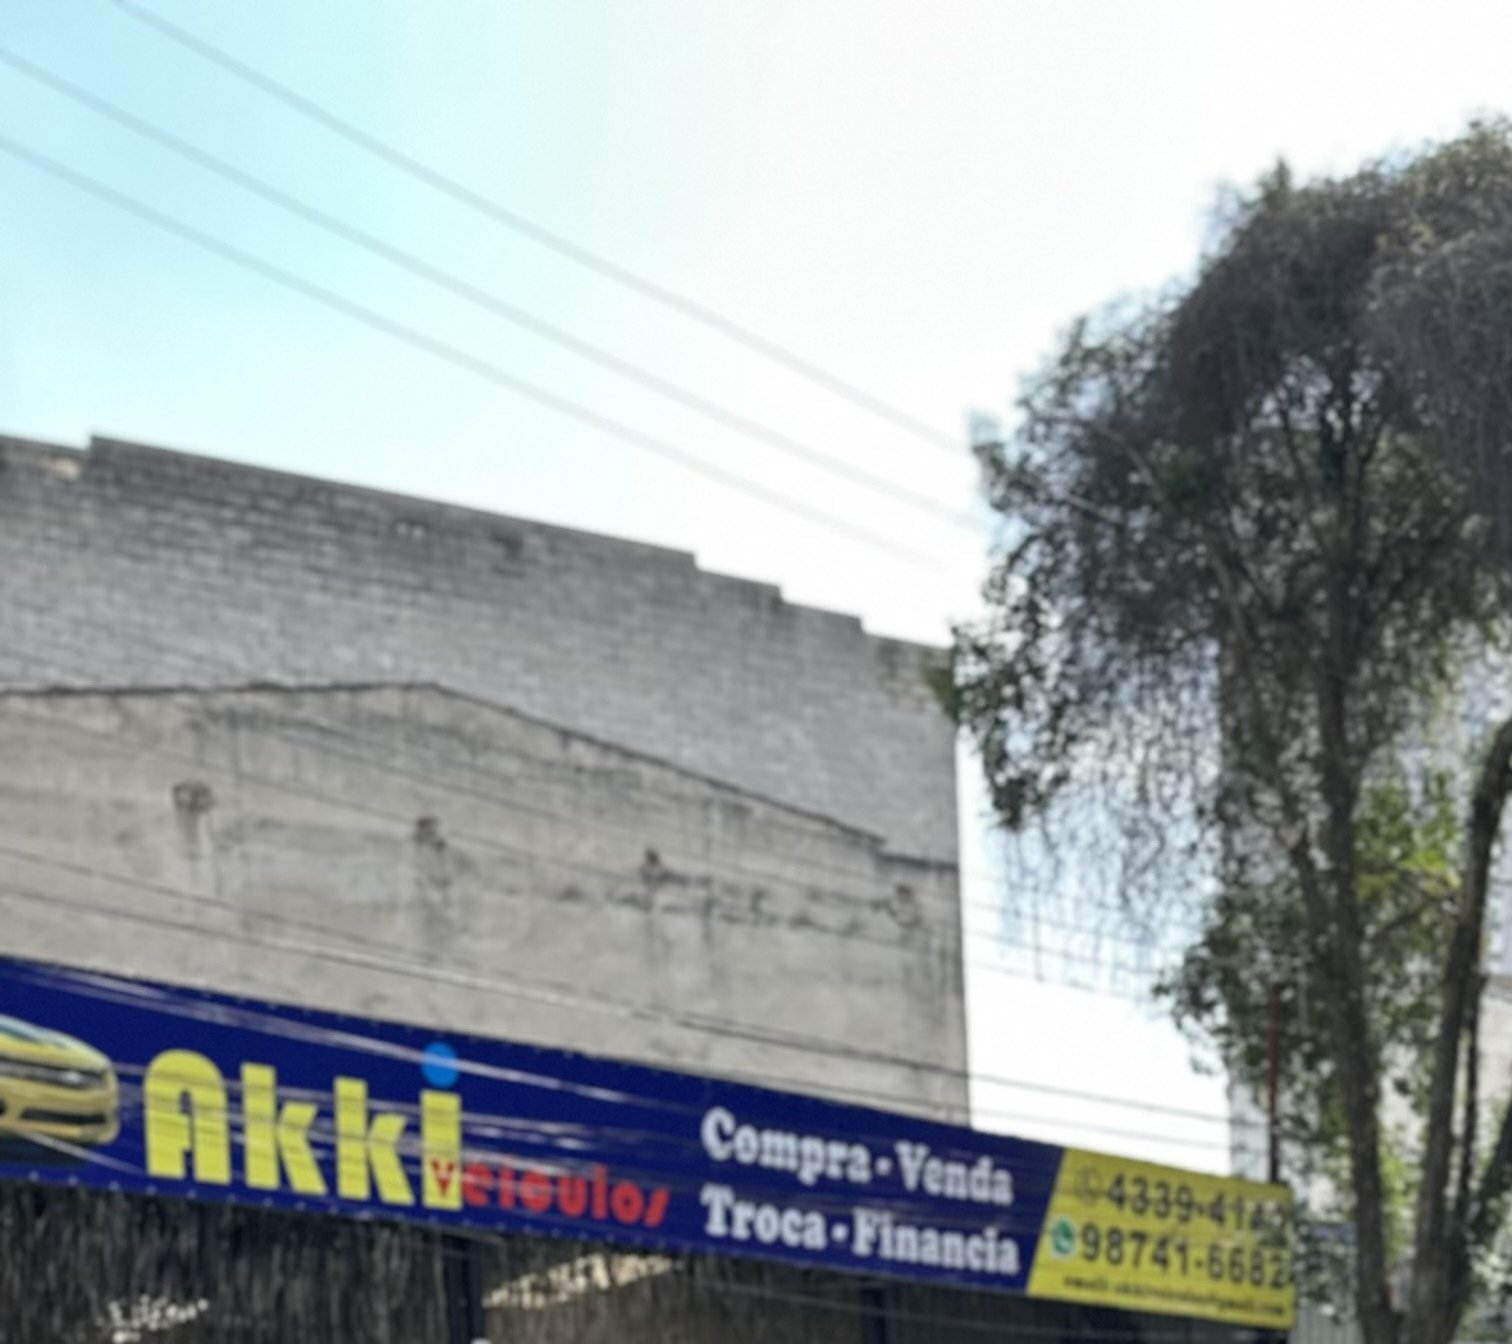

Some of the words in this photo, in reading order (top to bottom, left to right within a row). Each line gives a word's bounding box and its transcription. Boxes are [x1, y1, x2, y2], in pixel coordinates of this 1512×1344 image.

[143, 1042, 464, 1212] Akki
[701, 1106, 872, 1186] Compra
[896, 1139, 1014, 1206] Venda
[700, 1181, 828, 1251] Troca
[852, 1206, 1020, 1275] Financia
